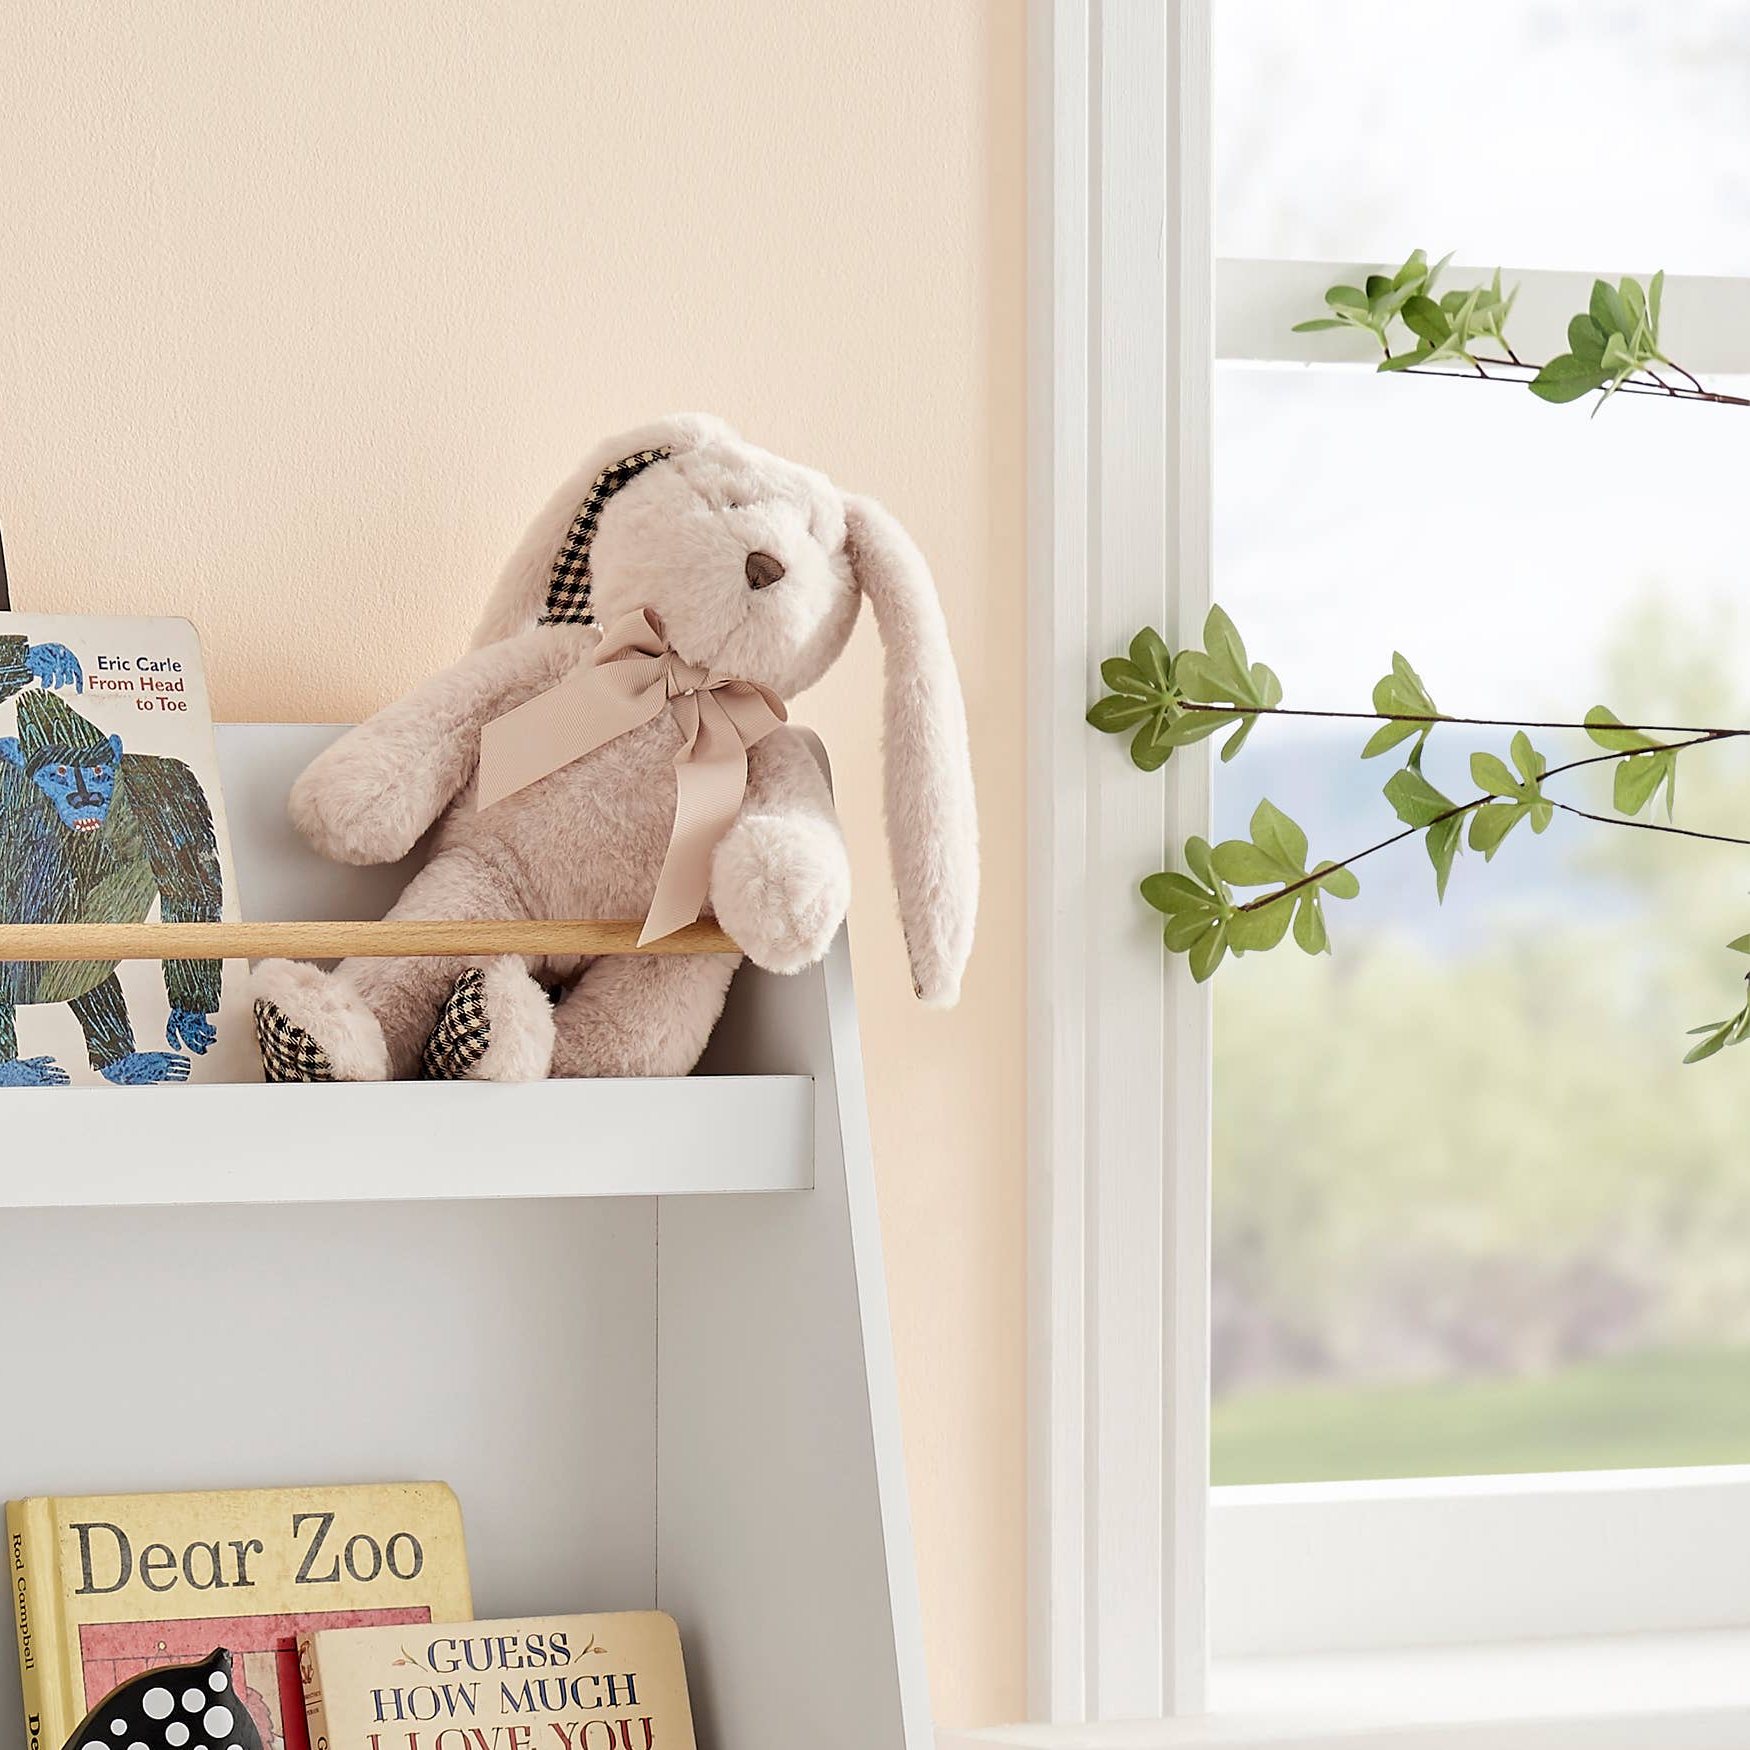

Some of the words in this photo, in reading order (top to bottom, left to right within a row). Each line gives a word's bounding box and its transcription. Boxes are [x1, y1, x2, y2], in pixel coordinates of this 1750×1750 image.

[88, 675, 134, 690] From
[139, 676, 185, 692] Head
[97, 655, 131, 671] Eric
[136, 656, 182, 672] Carle
[136, 697, 154, 711] to
[155, 696, 188, 711] Toe
[12, 1533, 25, 1571] Rod
[68, 1520, 265, 1596] Dear
[291, 1511, 426, 1586] Zoo
[17, 1576, 36, 1671] Campbell
[426, 1631, 574, 1674] GUESS
[369, 1679, 484, 1724] HOW
[498, 1671, 641, 1715] MUCH
